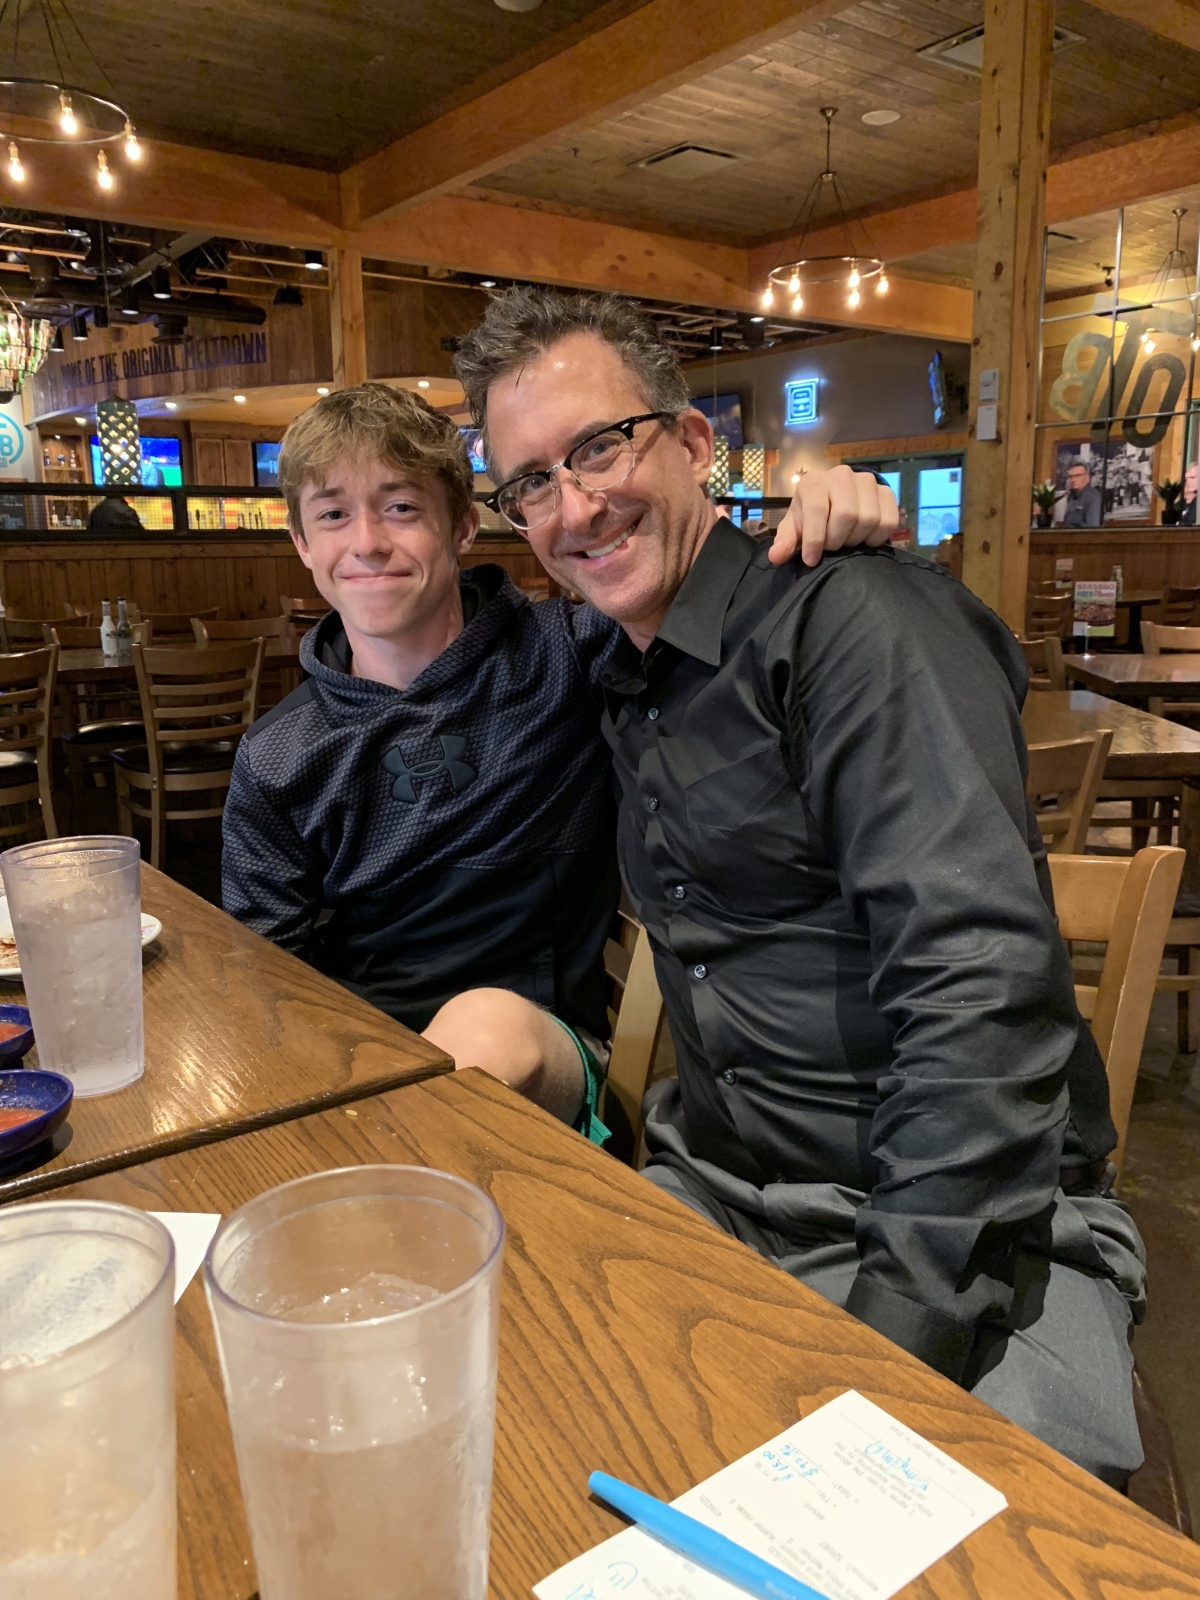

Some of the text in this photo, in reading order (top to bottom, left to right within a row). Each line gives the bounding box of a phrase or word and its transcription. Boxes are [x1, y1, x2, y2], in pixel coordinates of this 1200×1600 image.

[85, 356, 96, 385] OF
[99, 353, 117, 382] THE
[122, 344, 180, 379] ORIGINAL
[184, 332, 266, 370] MELTDOWN
